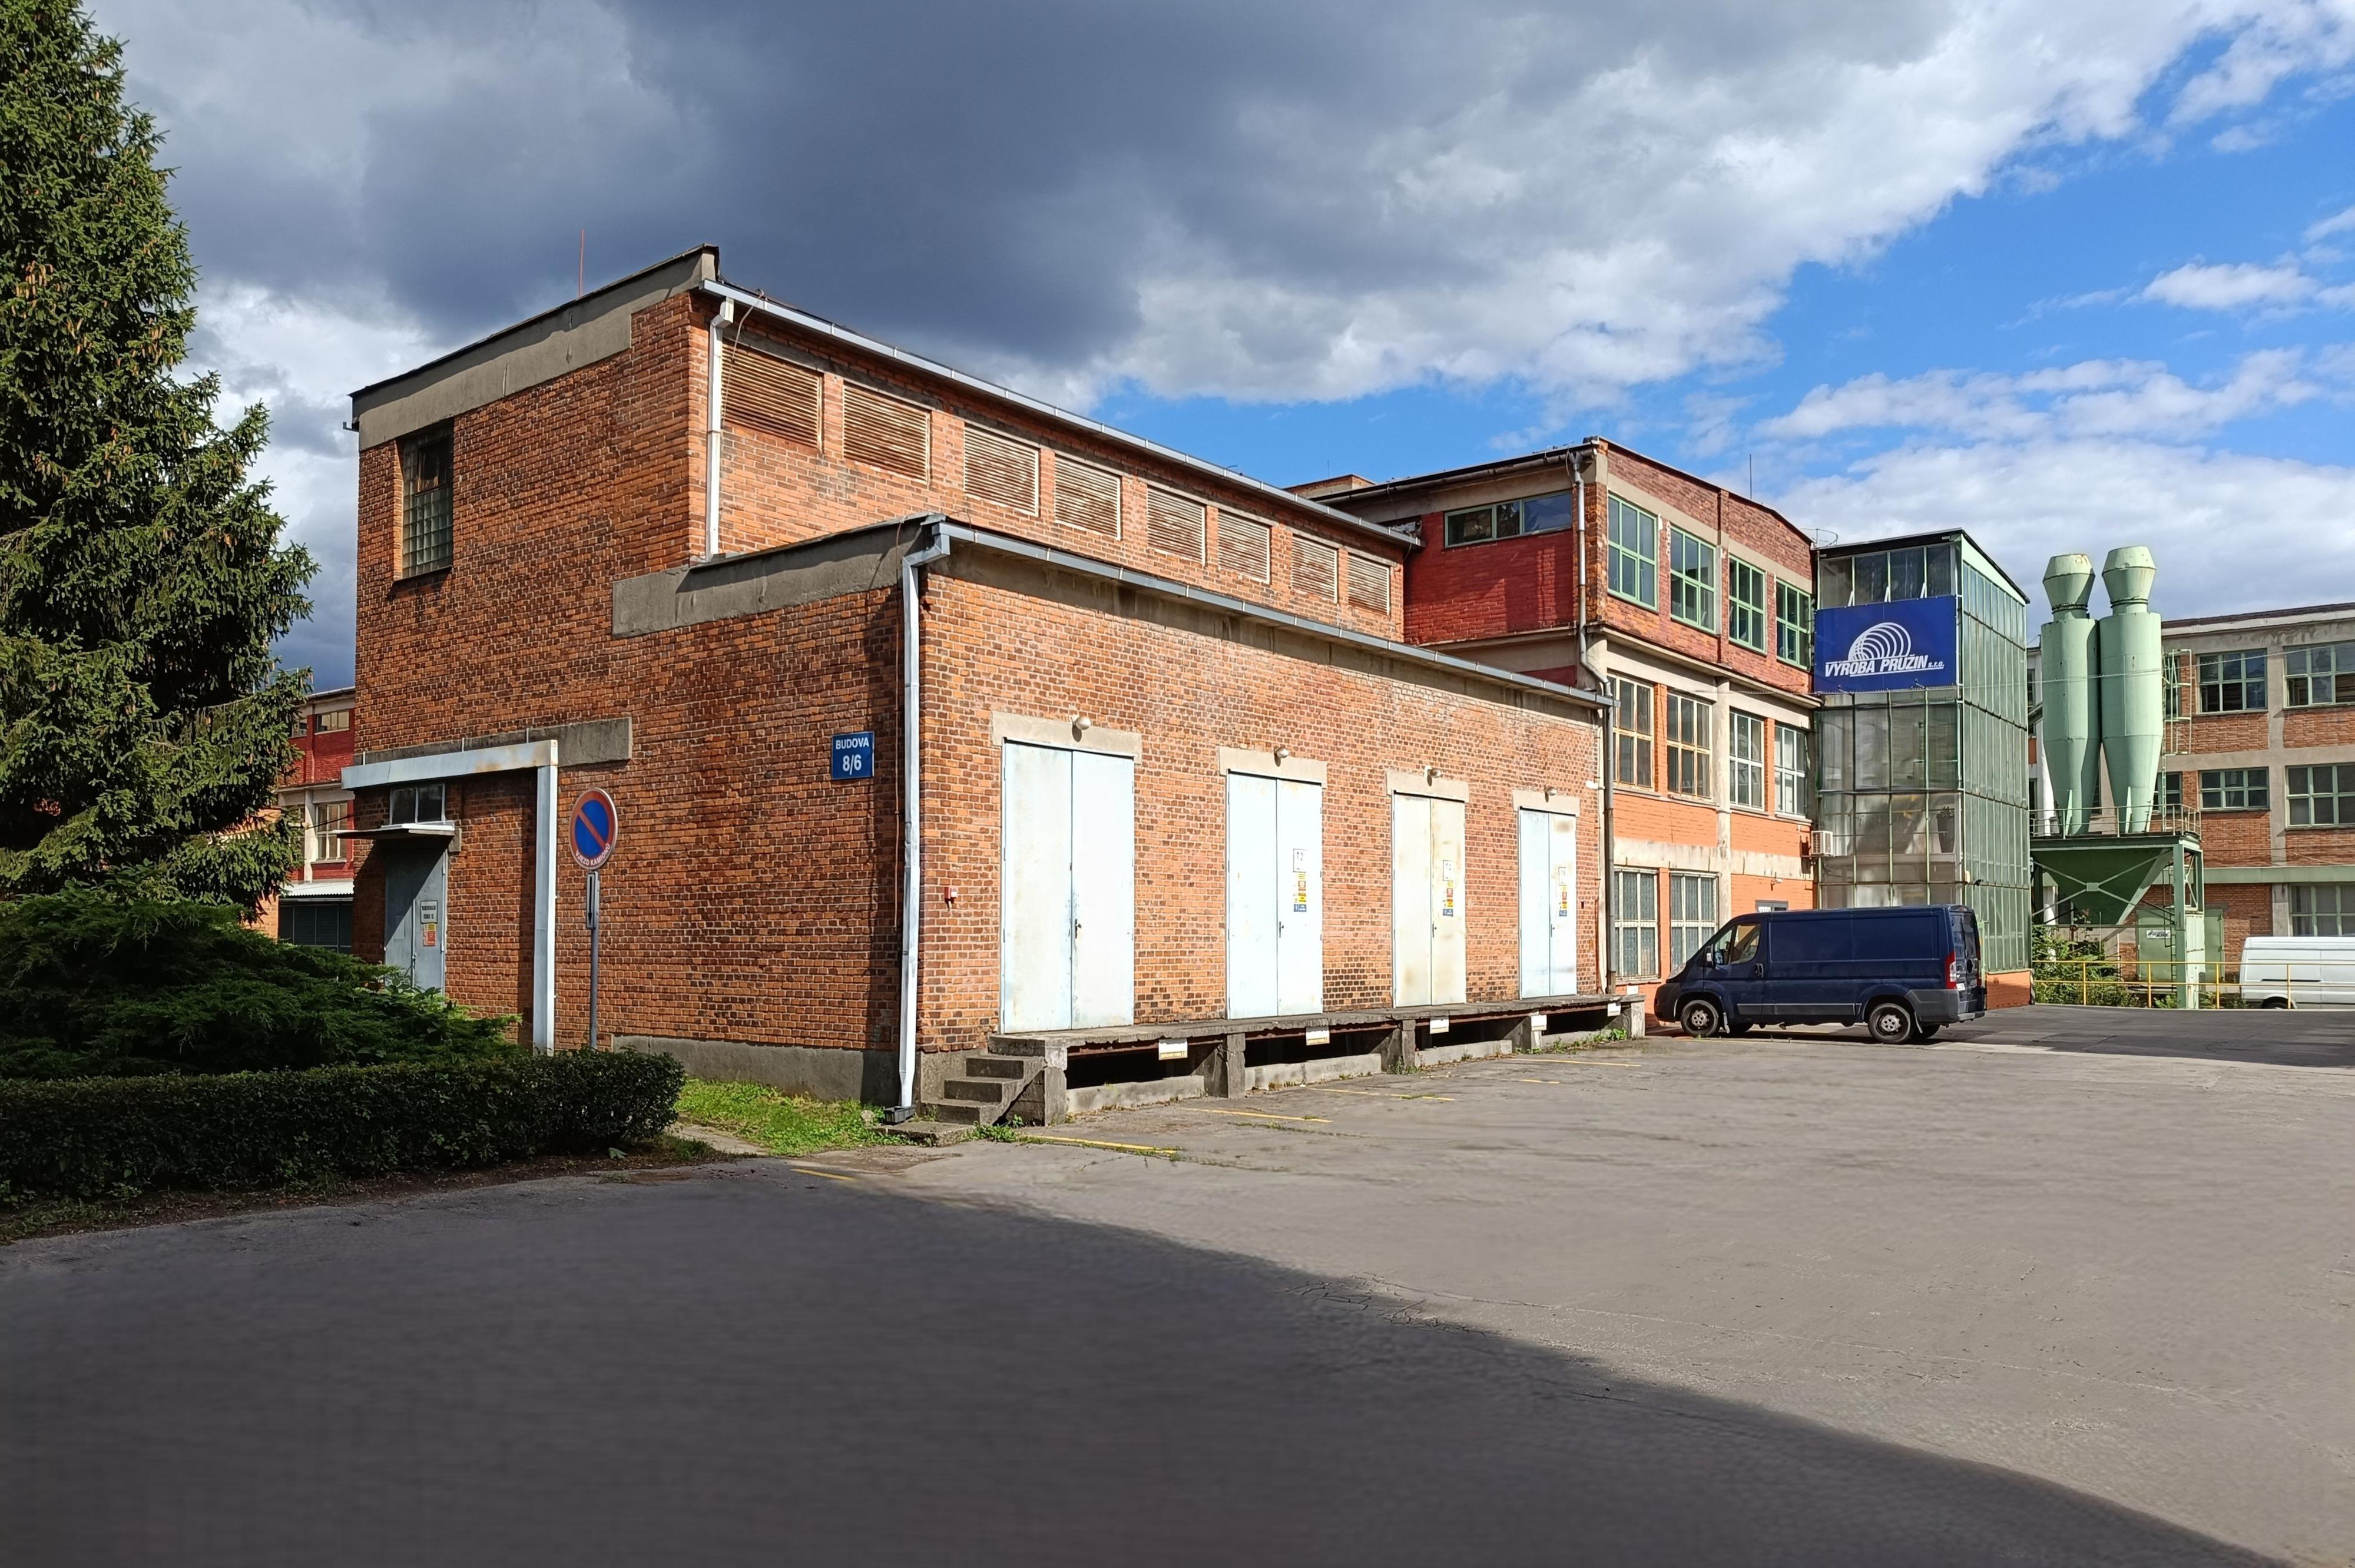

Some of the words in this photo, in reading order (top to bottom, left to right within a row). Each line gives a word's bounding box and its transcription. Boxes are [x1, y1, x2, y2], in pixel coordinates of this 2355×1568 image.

[1880, 654, 1929, 672] PRUŽIN
[836, 737, 869, 750] BUDOVA
[842, 754, 862, 775] 8/6
[575, 850, 590, 866] VJEZD
